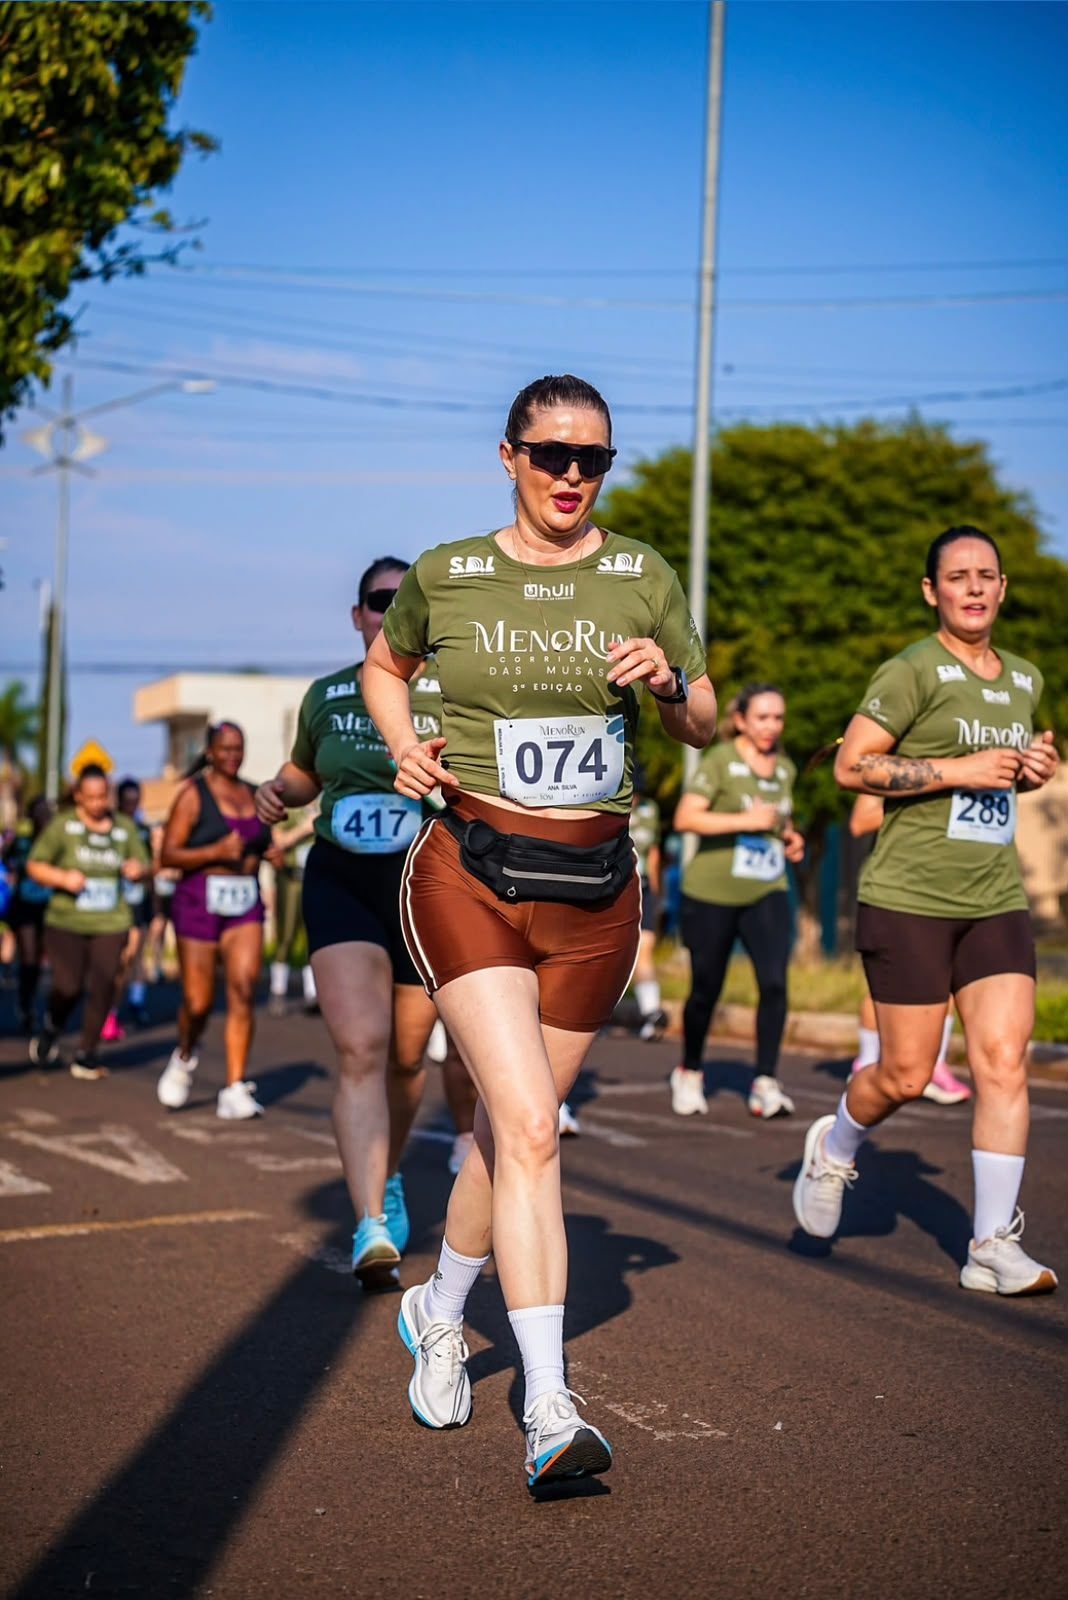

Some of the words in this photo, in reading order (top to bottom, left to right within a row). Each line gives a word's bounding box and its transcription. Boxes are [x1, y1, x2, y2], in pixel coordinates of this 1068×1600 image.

[489, 666, 522, 676] DAS
[546, 666, 605, 677] MUSAS
[499, 655, 590, 664] CORRIDA
[533, 682, 583, 692] EDIÇÃO
[953, 717, 1034, 754] MENORU
[515, 738, 608, 785] 074
[343, 808, 408, 838] 417
[957, 791, 1011, 826] 289
